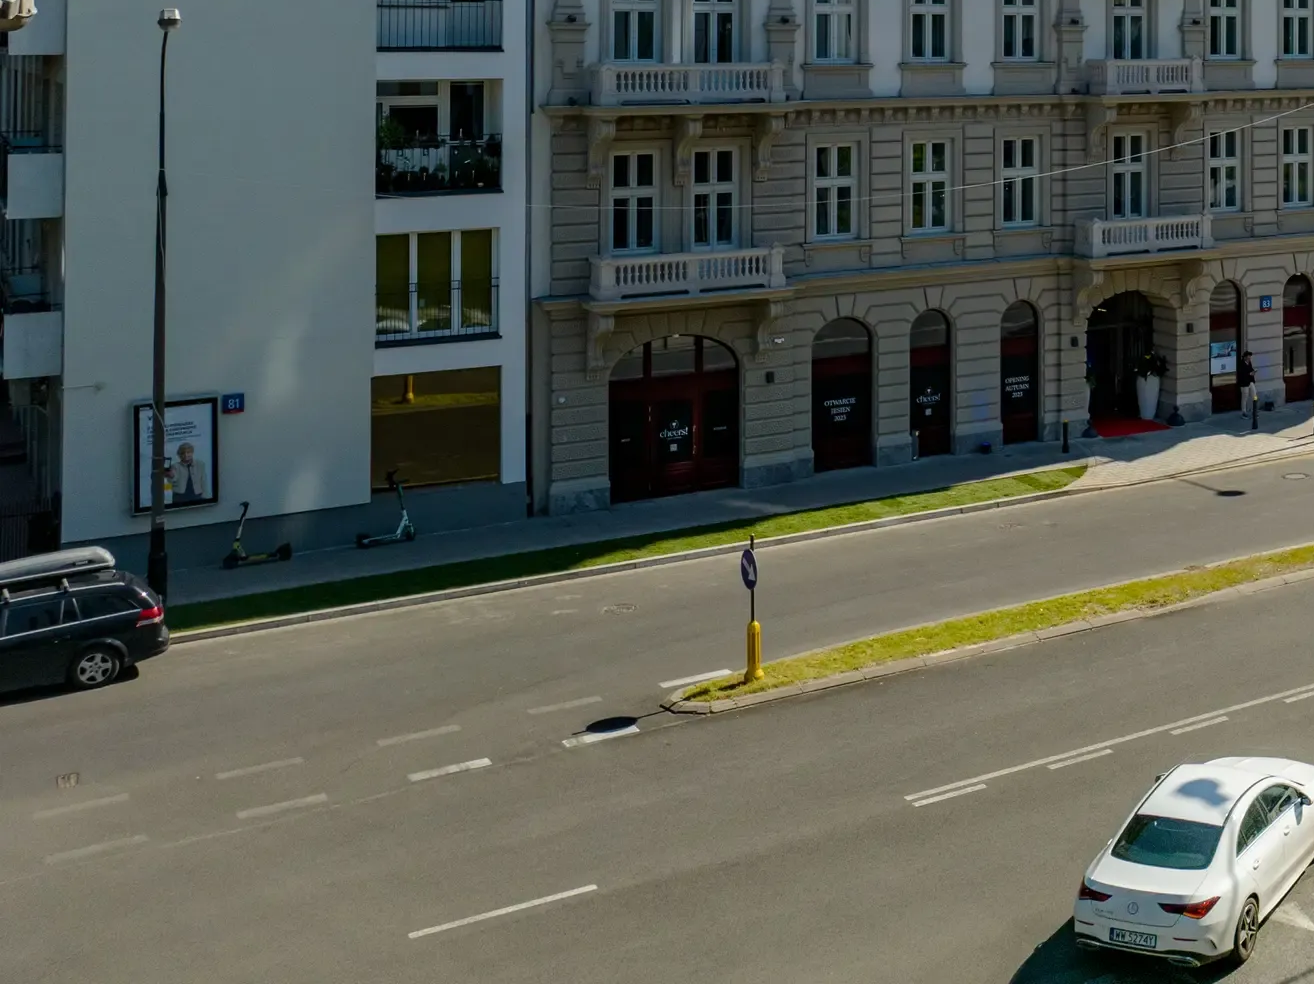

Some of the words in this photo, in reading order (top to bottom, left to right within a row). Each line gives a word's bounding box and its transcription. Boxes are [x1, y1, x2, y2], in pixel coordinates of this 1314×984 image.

[1262, 300, 1270, 308] 83
[228, 398, 240, 409] 81
[660, 426, 688, 438] cheers!
[1128, 932, 1154, 945] 5274Y
